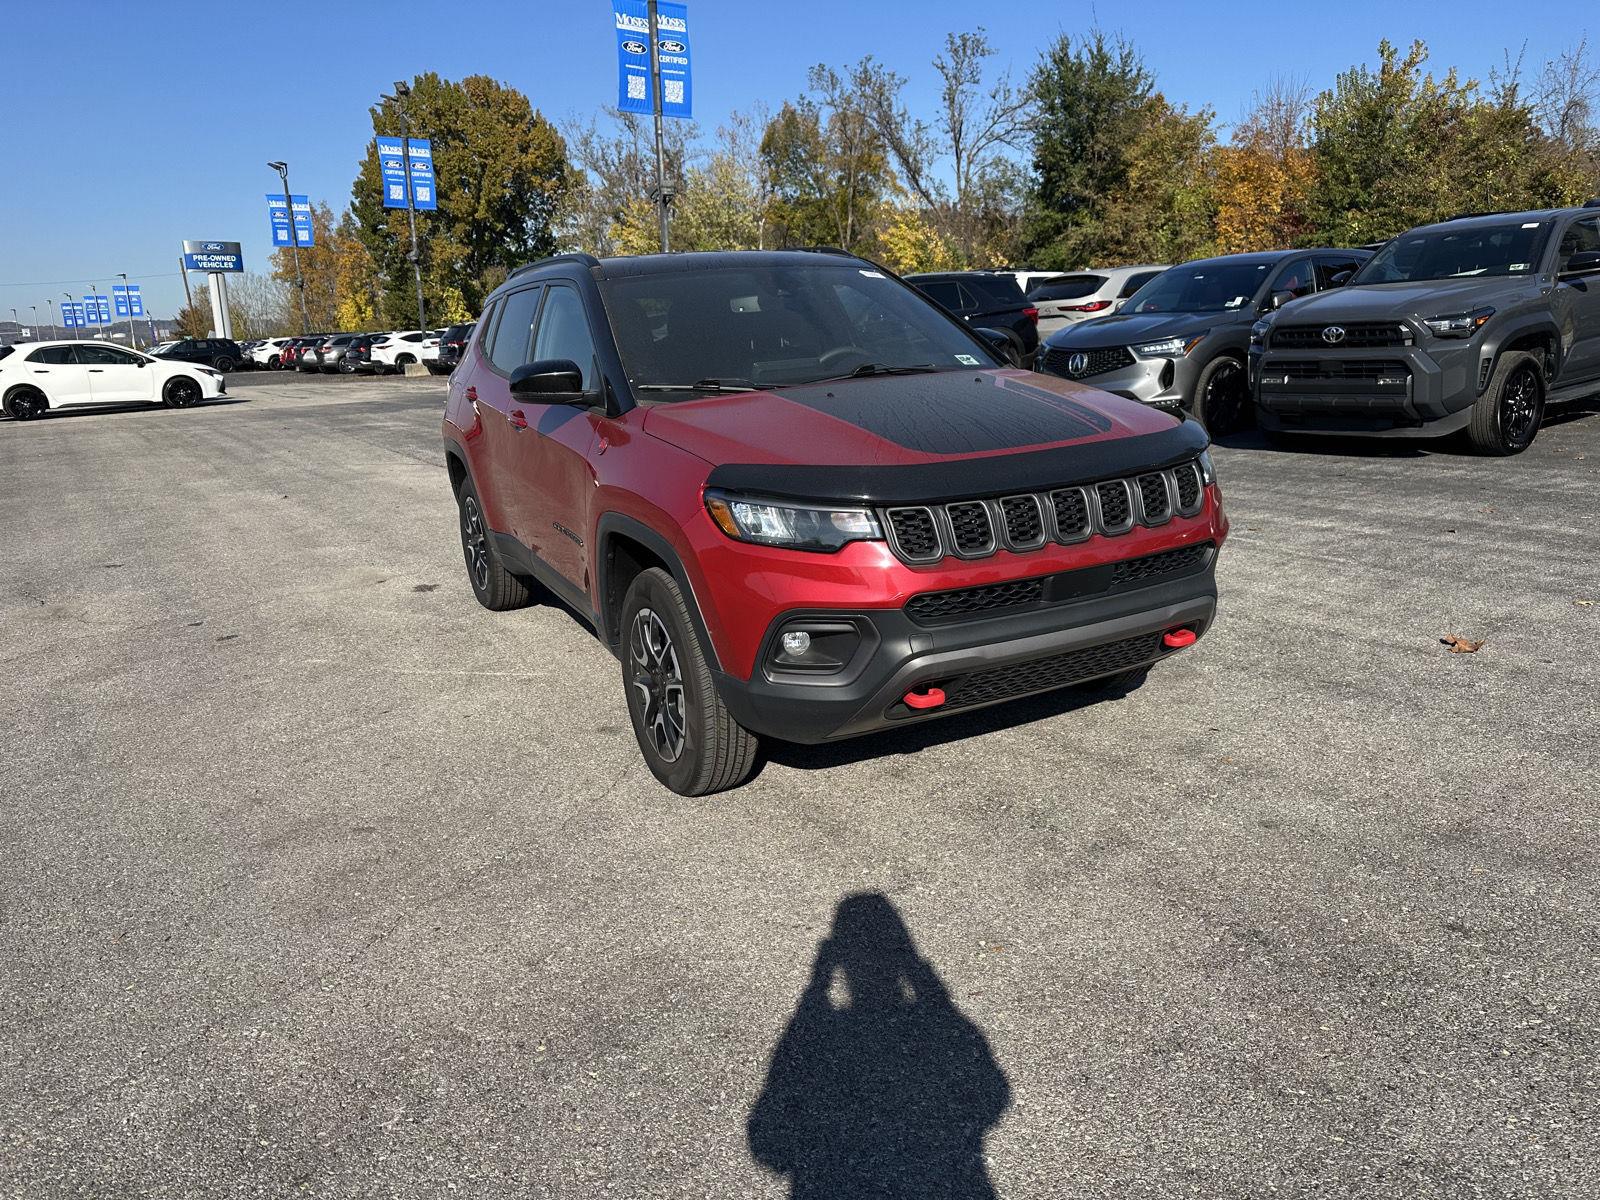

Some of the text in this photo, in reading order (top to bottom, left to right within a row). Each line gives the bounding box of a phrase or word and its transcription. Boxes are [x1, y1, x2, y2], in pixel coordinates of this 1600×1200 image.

[615, 12, 649, 28] MOSES
[656, 14, 686, 28] MOSES
[659, 55, 688, 65] CERTIFIED
[192, 254, 236, 262] PRE-OWNED
[197, 261, 234, 269] VEHICLES
